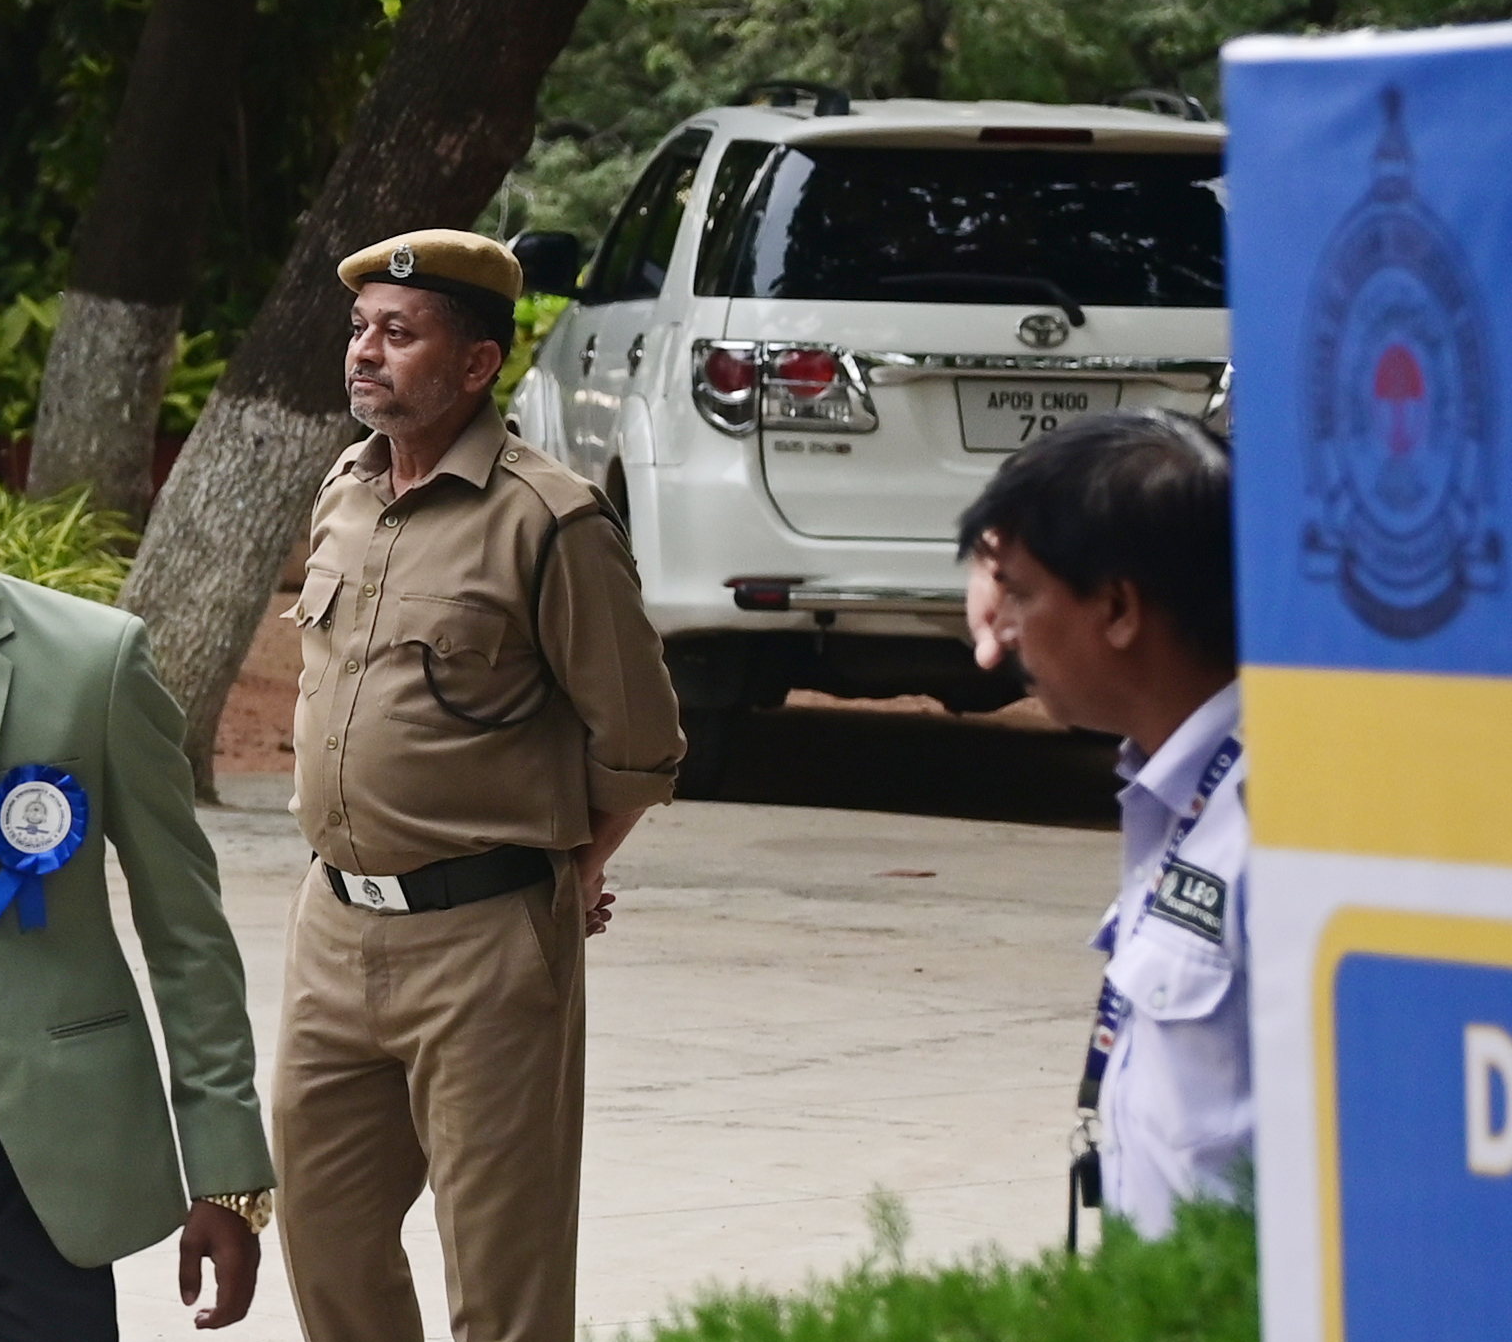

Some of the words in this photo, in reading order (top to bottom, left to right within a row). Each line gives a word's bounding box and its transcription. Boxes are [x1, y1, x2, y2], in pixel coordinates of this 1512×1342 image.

[987, 390, 1034, 410] AP09
[1181, 876, 1219, 908] LEO
[1464, 1022, 1512, 1176] D
